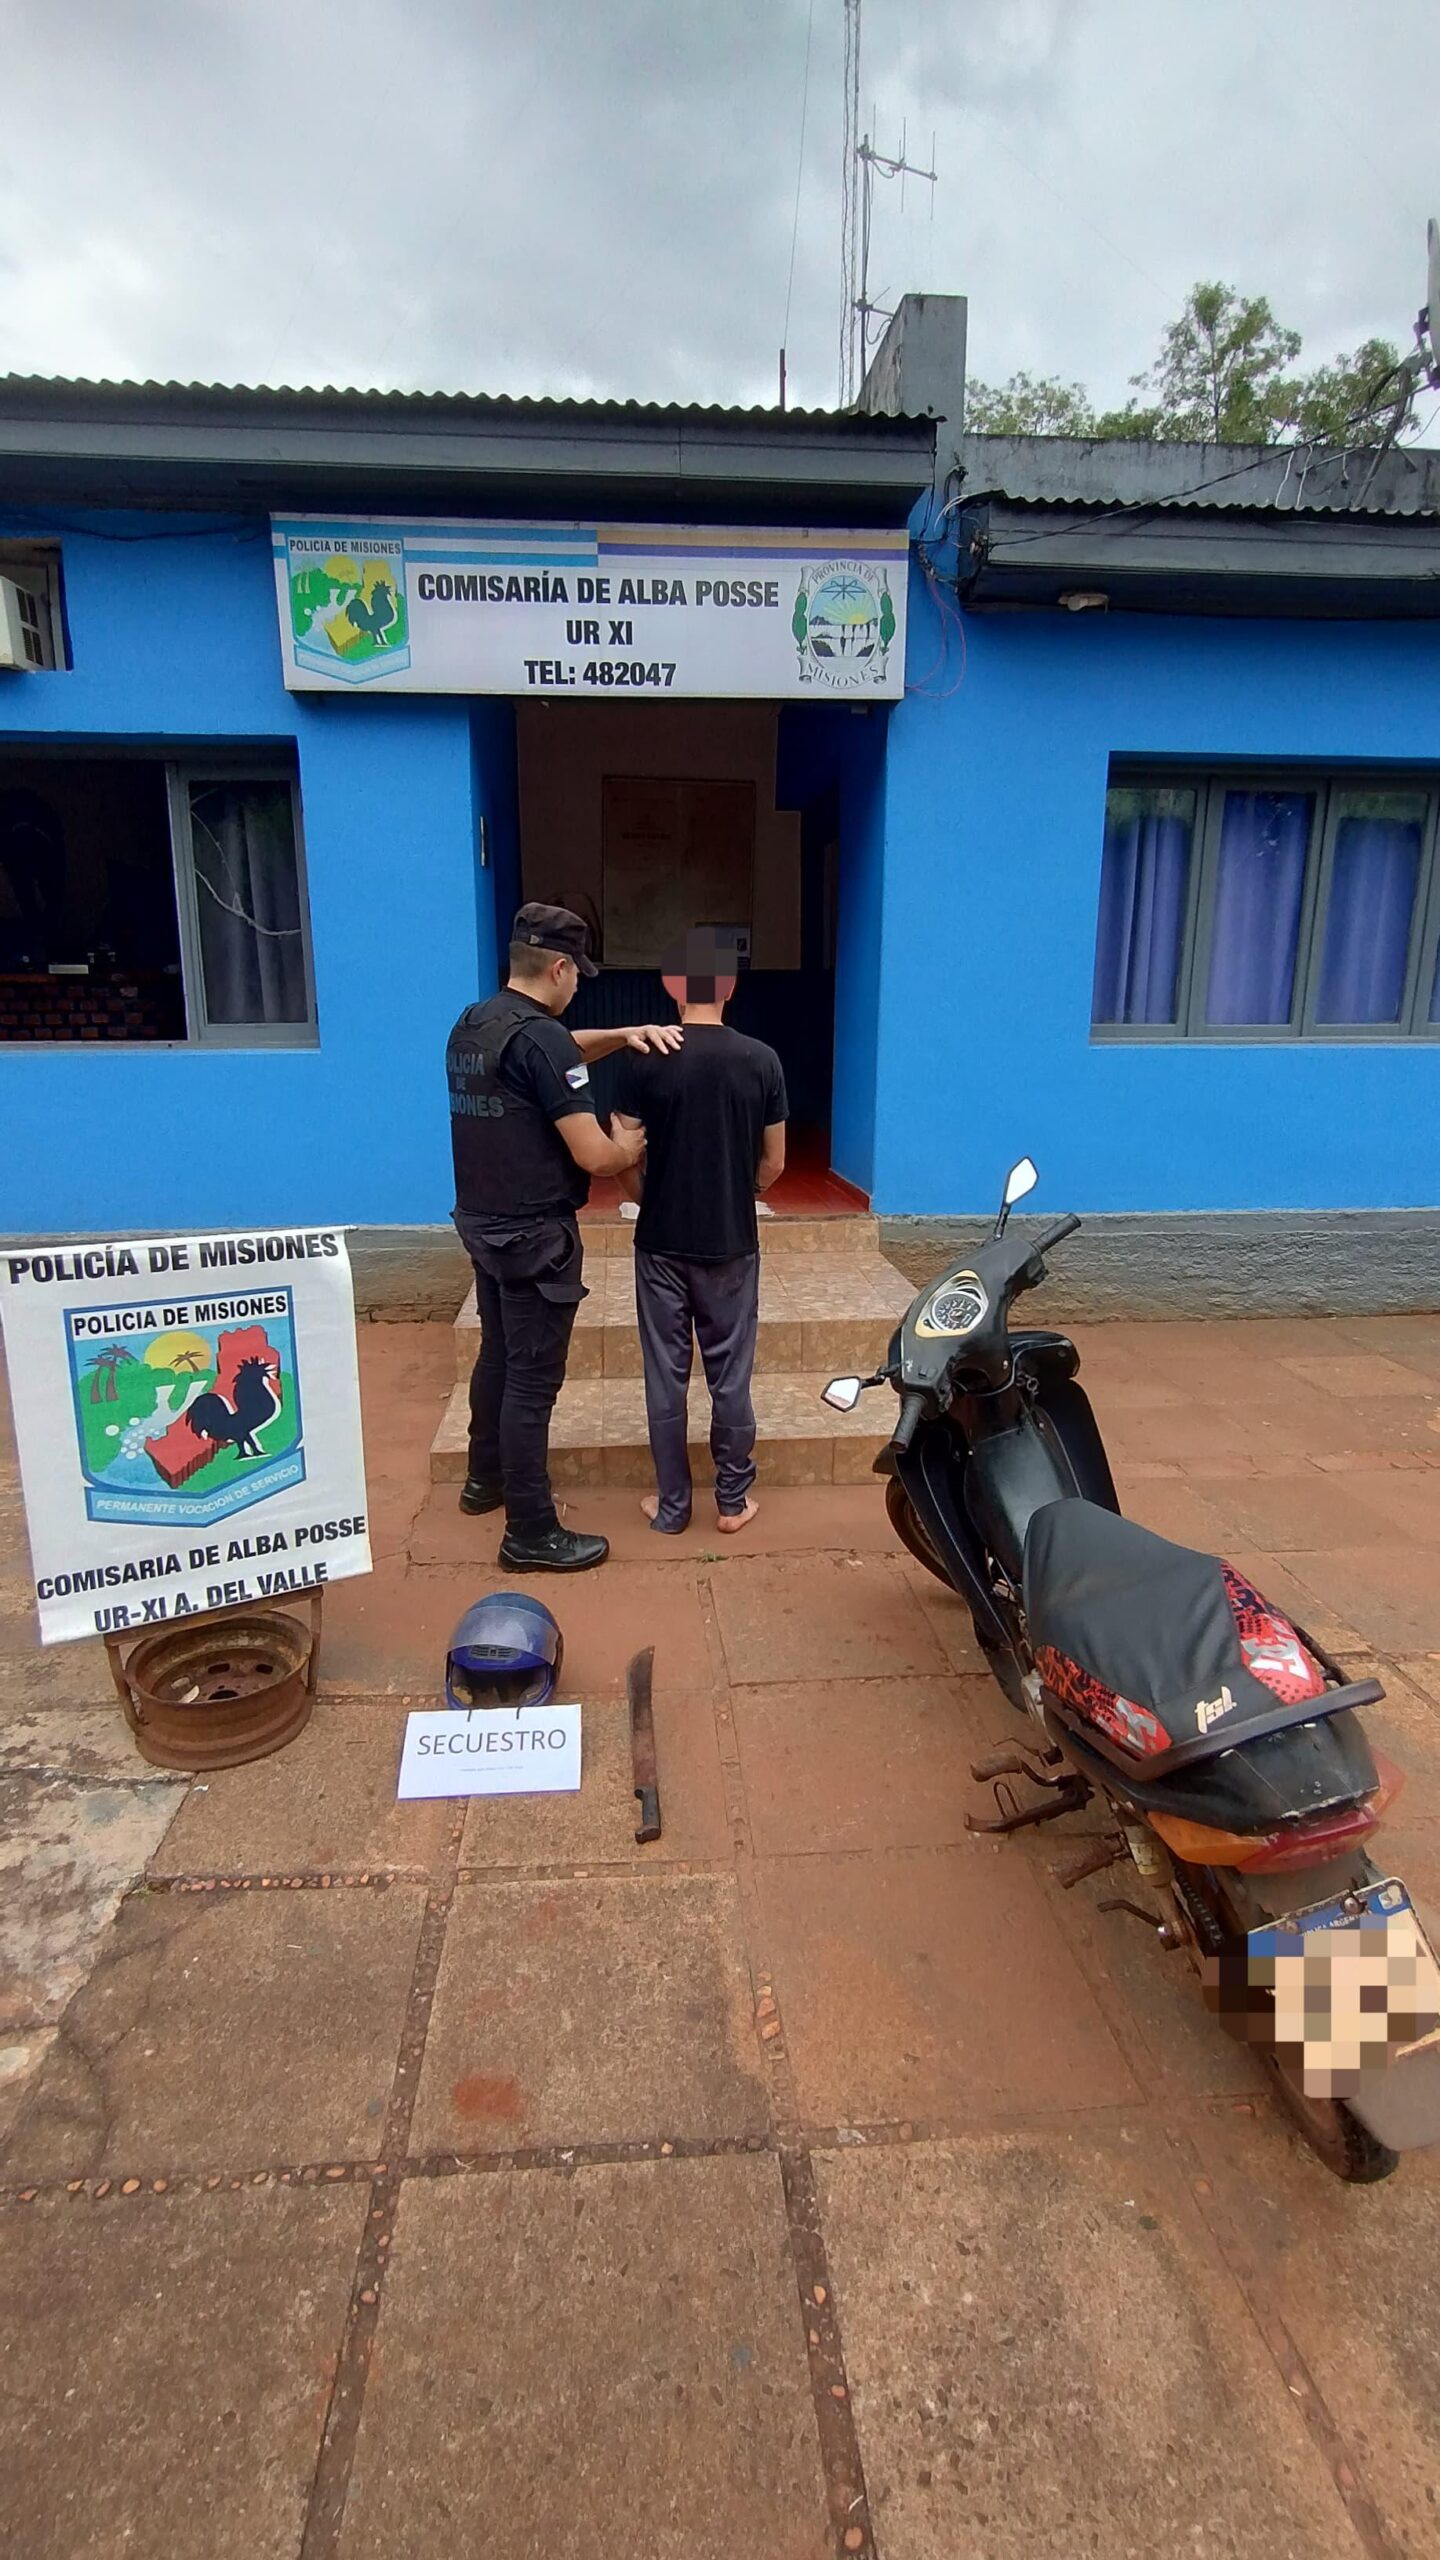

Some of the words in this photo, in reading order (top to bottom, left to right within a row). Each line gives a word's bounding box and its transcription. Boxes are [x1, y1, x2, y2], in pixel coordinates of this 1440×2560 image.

[290, 539, 331, 552] POLICIA
[334, 541, 348, 553] DE
[350, 542, 401, 555] MISIONES
[812, 560, 863, 585] PROVINCIA
[418, 570, 569, 604] COMISARÍA
[577, 577, 611, 604] DE
[617, 579, 688, 606] ALBA
[696, 581, 779, 608] POSSE
[566, 620, 600, 646] UR
[608, 620, 634, 646] XI
[524, 660, 575, 686] TEL:
[583, 661, 677, 687] 482047
[807, 663, 879, 686] MISIONES
[448, 1053, 486, 1076] OLICIA
[8, 1245, 140, 1285] POLICÍA
[149, 1244, 190, 1273] DE
[199, 1233, 340, 1268] MISIONES
[73, 1311, 156, 1336] POLICIA
[163, 1307, 190, 1326] DE
[195, 1295, 288, 1323] MISIONES
[96, 1499, 177, 1514] PERMANENTE
[178, 1491, 235, 1514] VOCACION
[234, 1486, 250, 1499] DE
[251, 1464, 300, 1492] SERVICIO
[37, 1554, 182, 1600] COMISARIA
[189, 1545, 221, 1570] DE
[226, 1532, 288, 1562] ALBA
[295, 1515, 366, 1548] POSSE
[93, 1596, 168, 1632] UR-XI
[174, 1592, 199, 1615] A.
[206, 1579, 253, 1609] DEL
[256, 1562, 329, 1597] VALLE
[417, 1728, 567, 1756] SECUESTRO
